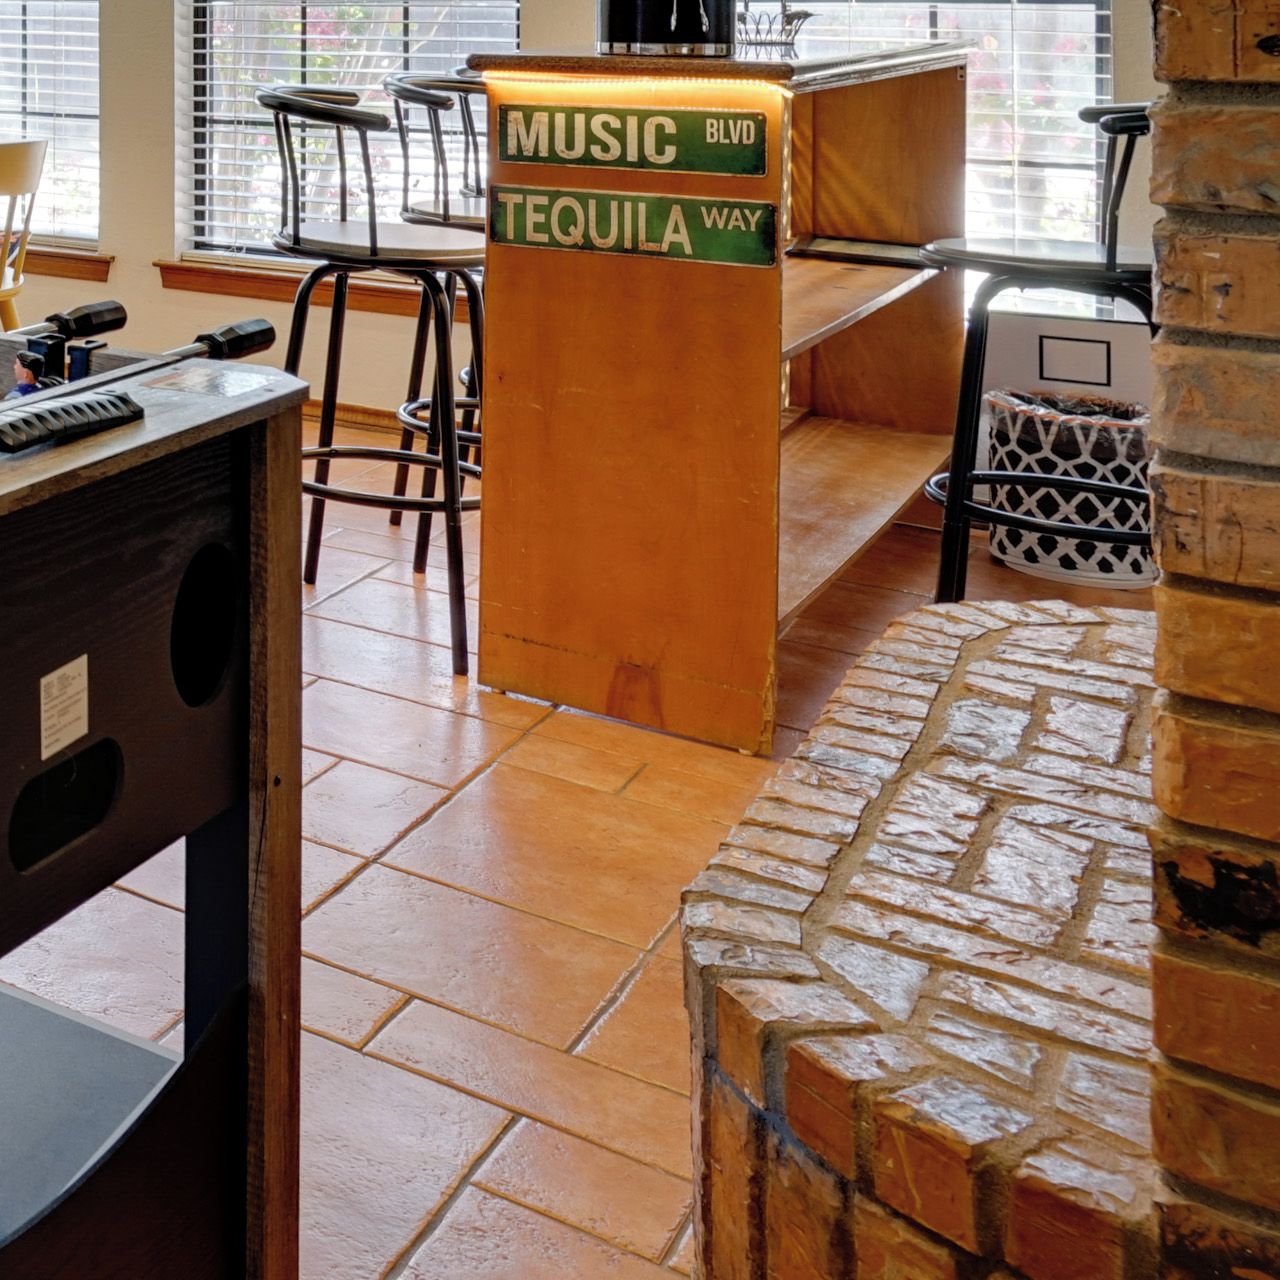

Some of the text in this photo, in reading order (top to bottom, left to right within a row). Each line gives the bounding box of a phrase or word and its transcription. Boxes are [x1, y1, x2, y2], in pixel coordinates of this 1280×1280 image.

[506, 110, 755, 165] MUSIC BLVD
[497, 192, 763, 255] TEQUILA WAY
